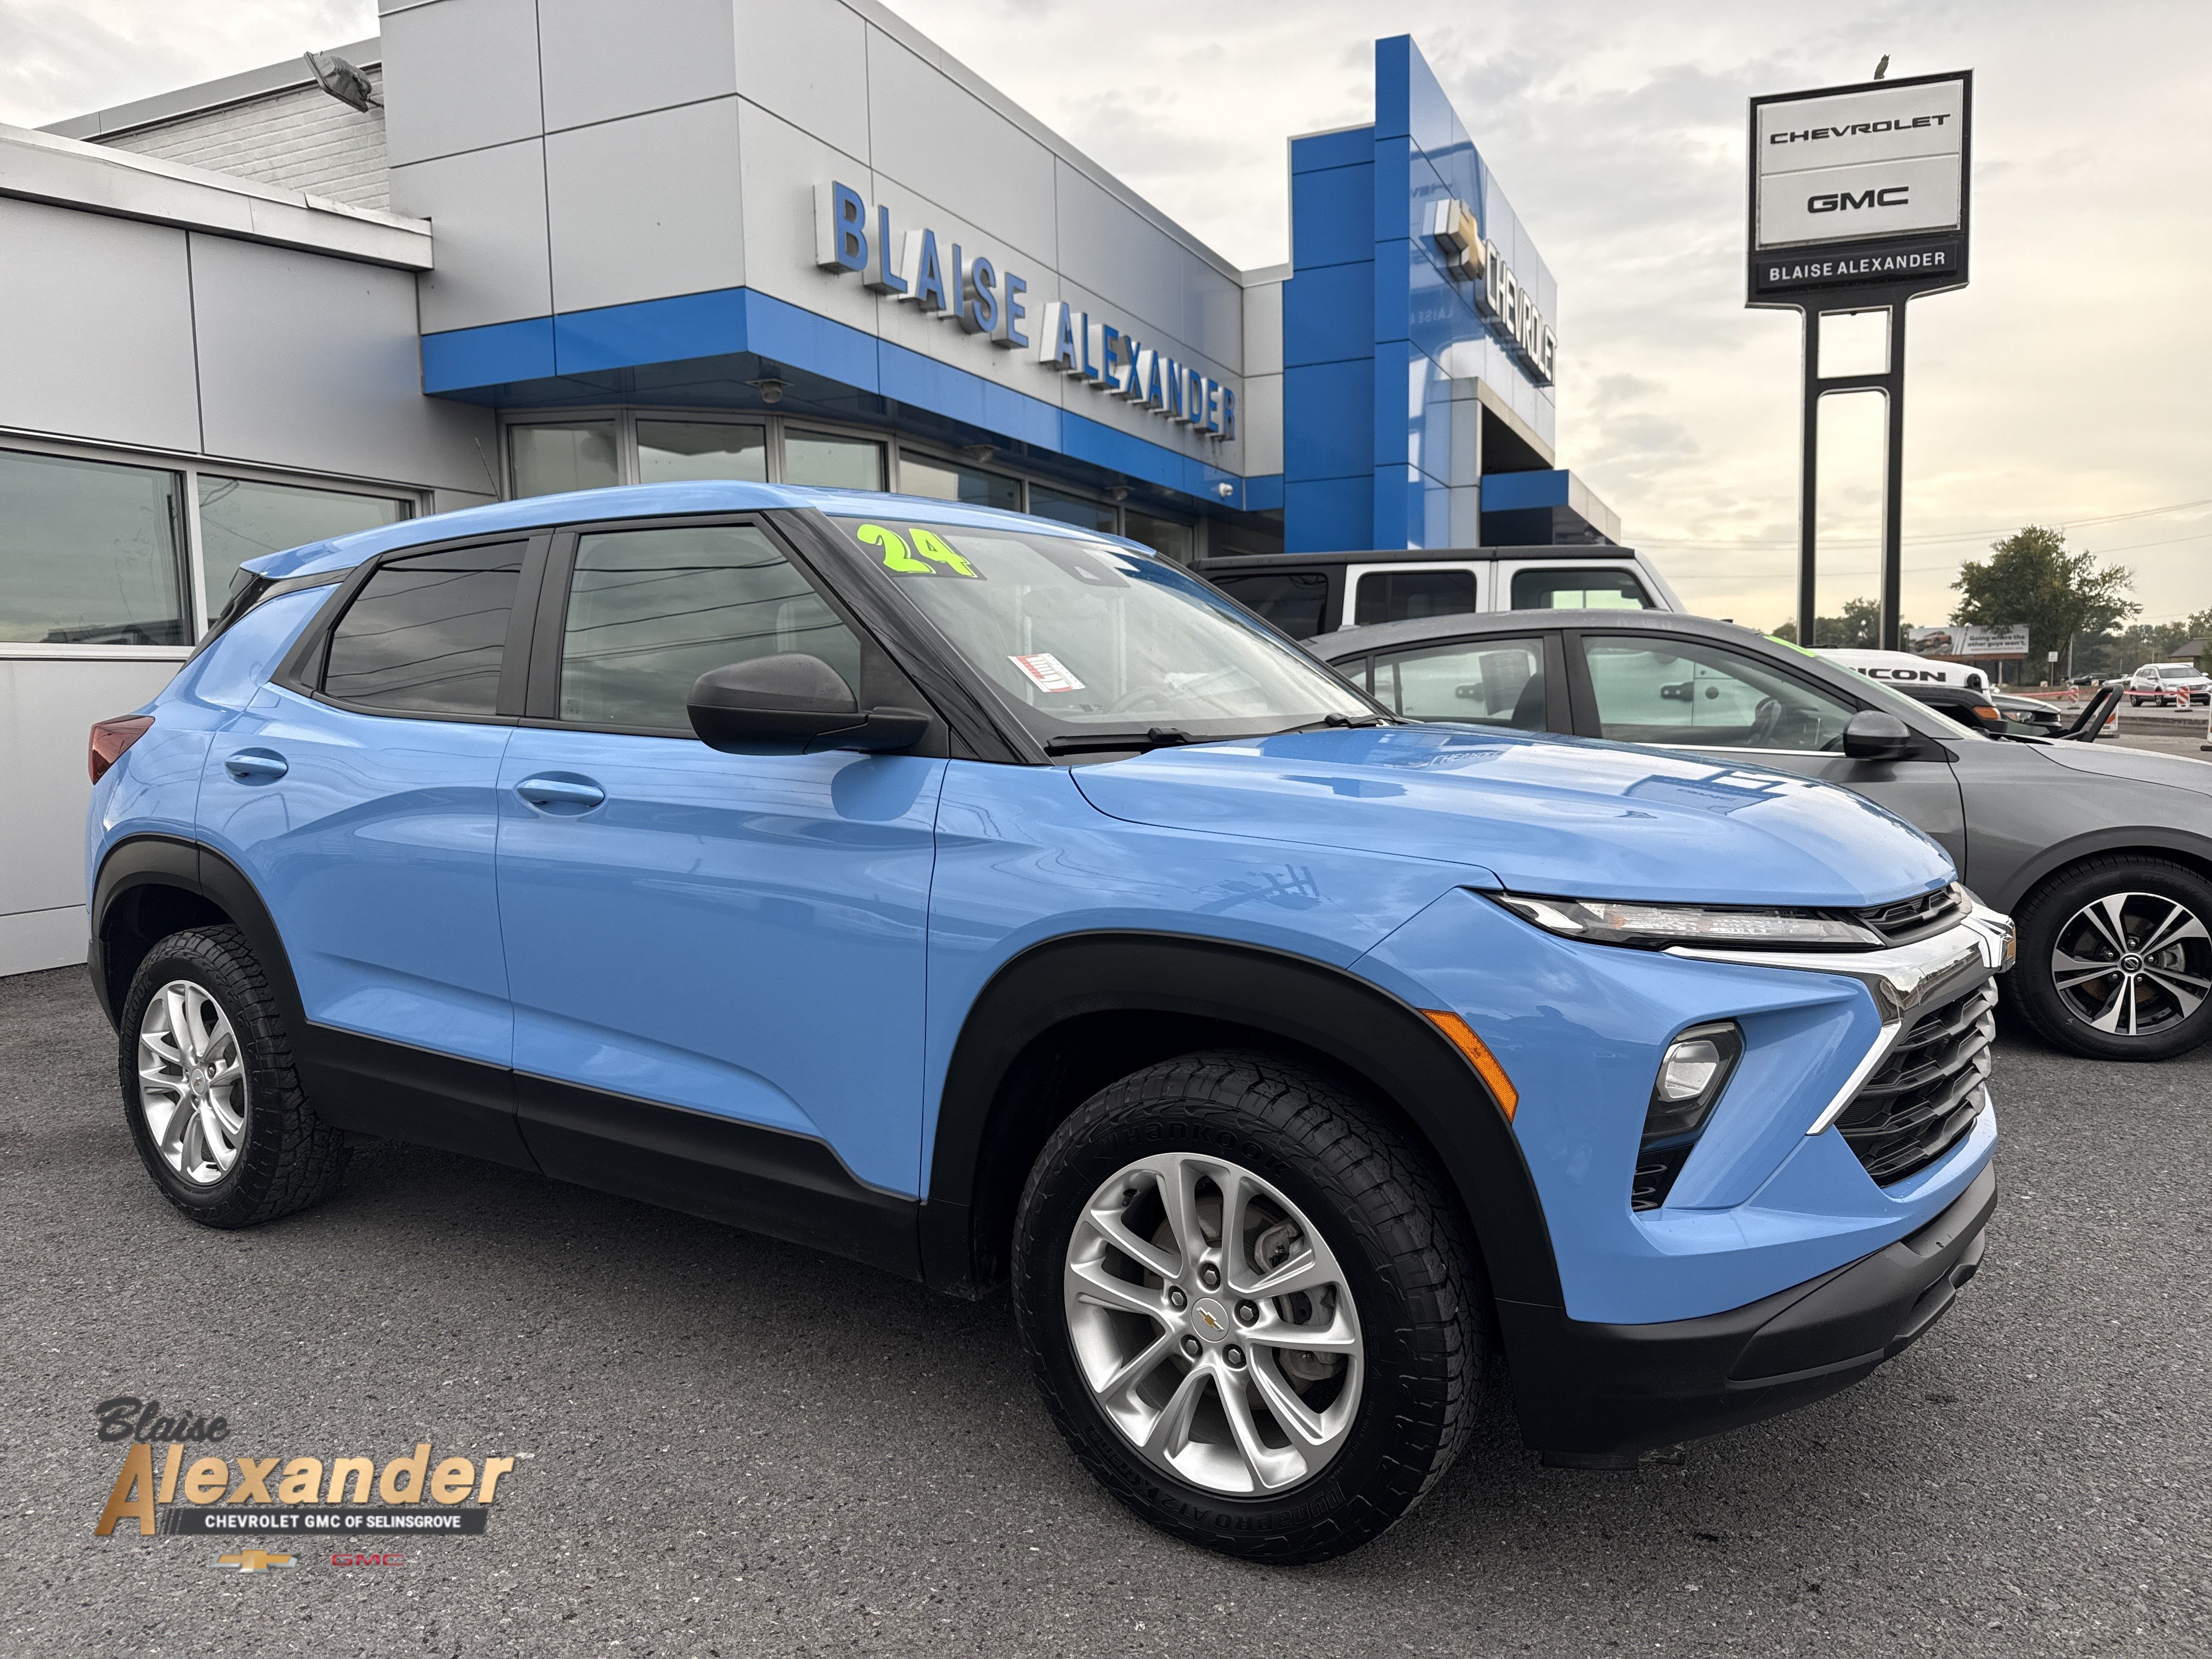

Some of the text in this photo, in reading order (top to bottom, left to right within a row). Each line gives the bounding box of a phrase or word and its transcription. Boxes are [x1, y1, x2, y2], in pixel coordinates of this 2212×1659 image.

[1770, 114, 1951, 145] CHEVROLET
[1808, 186, 1909, 214] GMC
[1770, 251, 1946, 281] BLAISE ALEXANDER
[832, 180, 1236, 441] BLAISE ALEXANDER
[857, 523, 978, 578] 24
[1160, 1493, 1212, 1523] AT2
